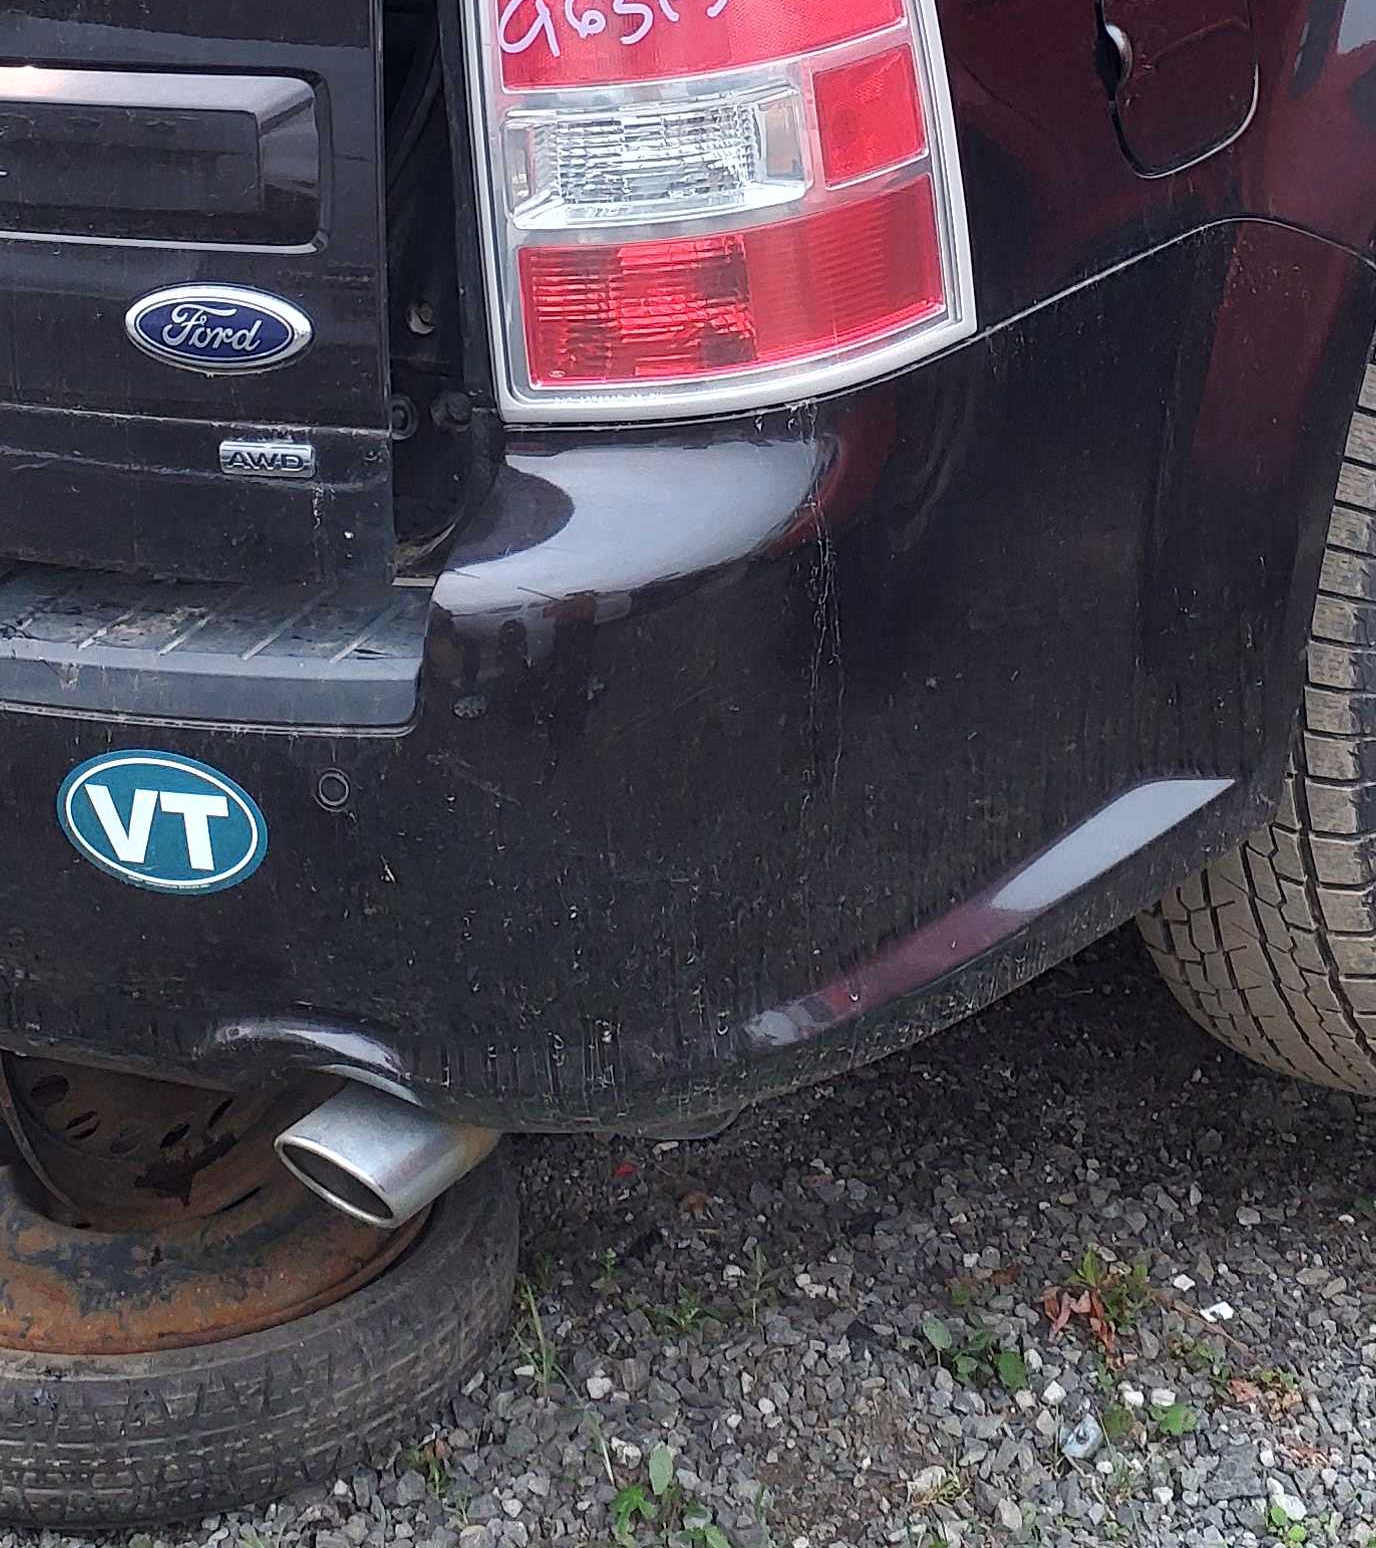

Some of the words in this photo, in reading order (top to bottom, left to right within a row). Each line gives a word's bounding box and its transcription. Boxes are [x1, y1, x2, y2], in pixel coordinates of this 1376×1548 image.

[161, 303, 263, 352] Ford
[227, 450, 305, 473] AWD
[84, 783, 230, 871] VT
